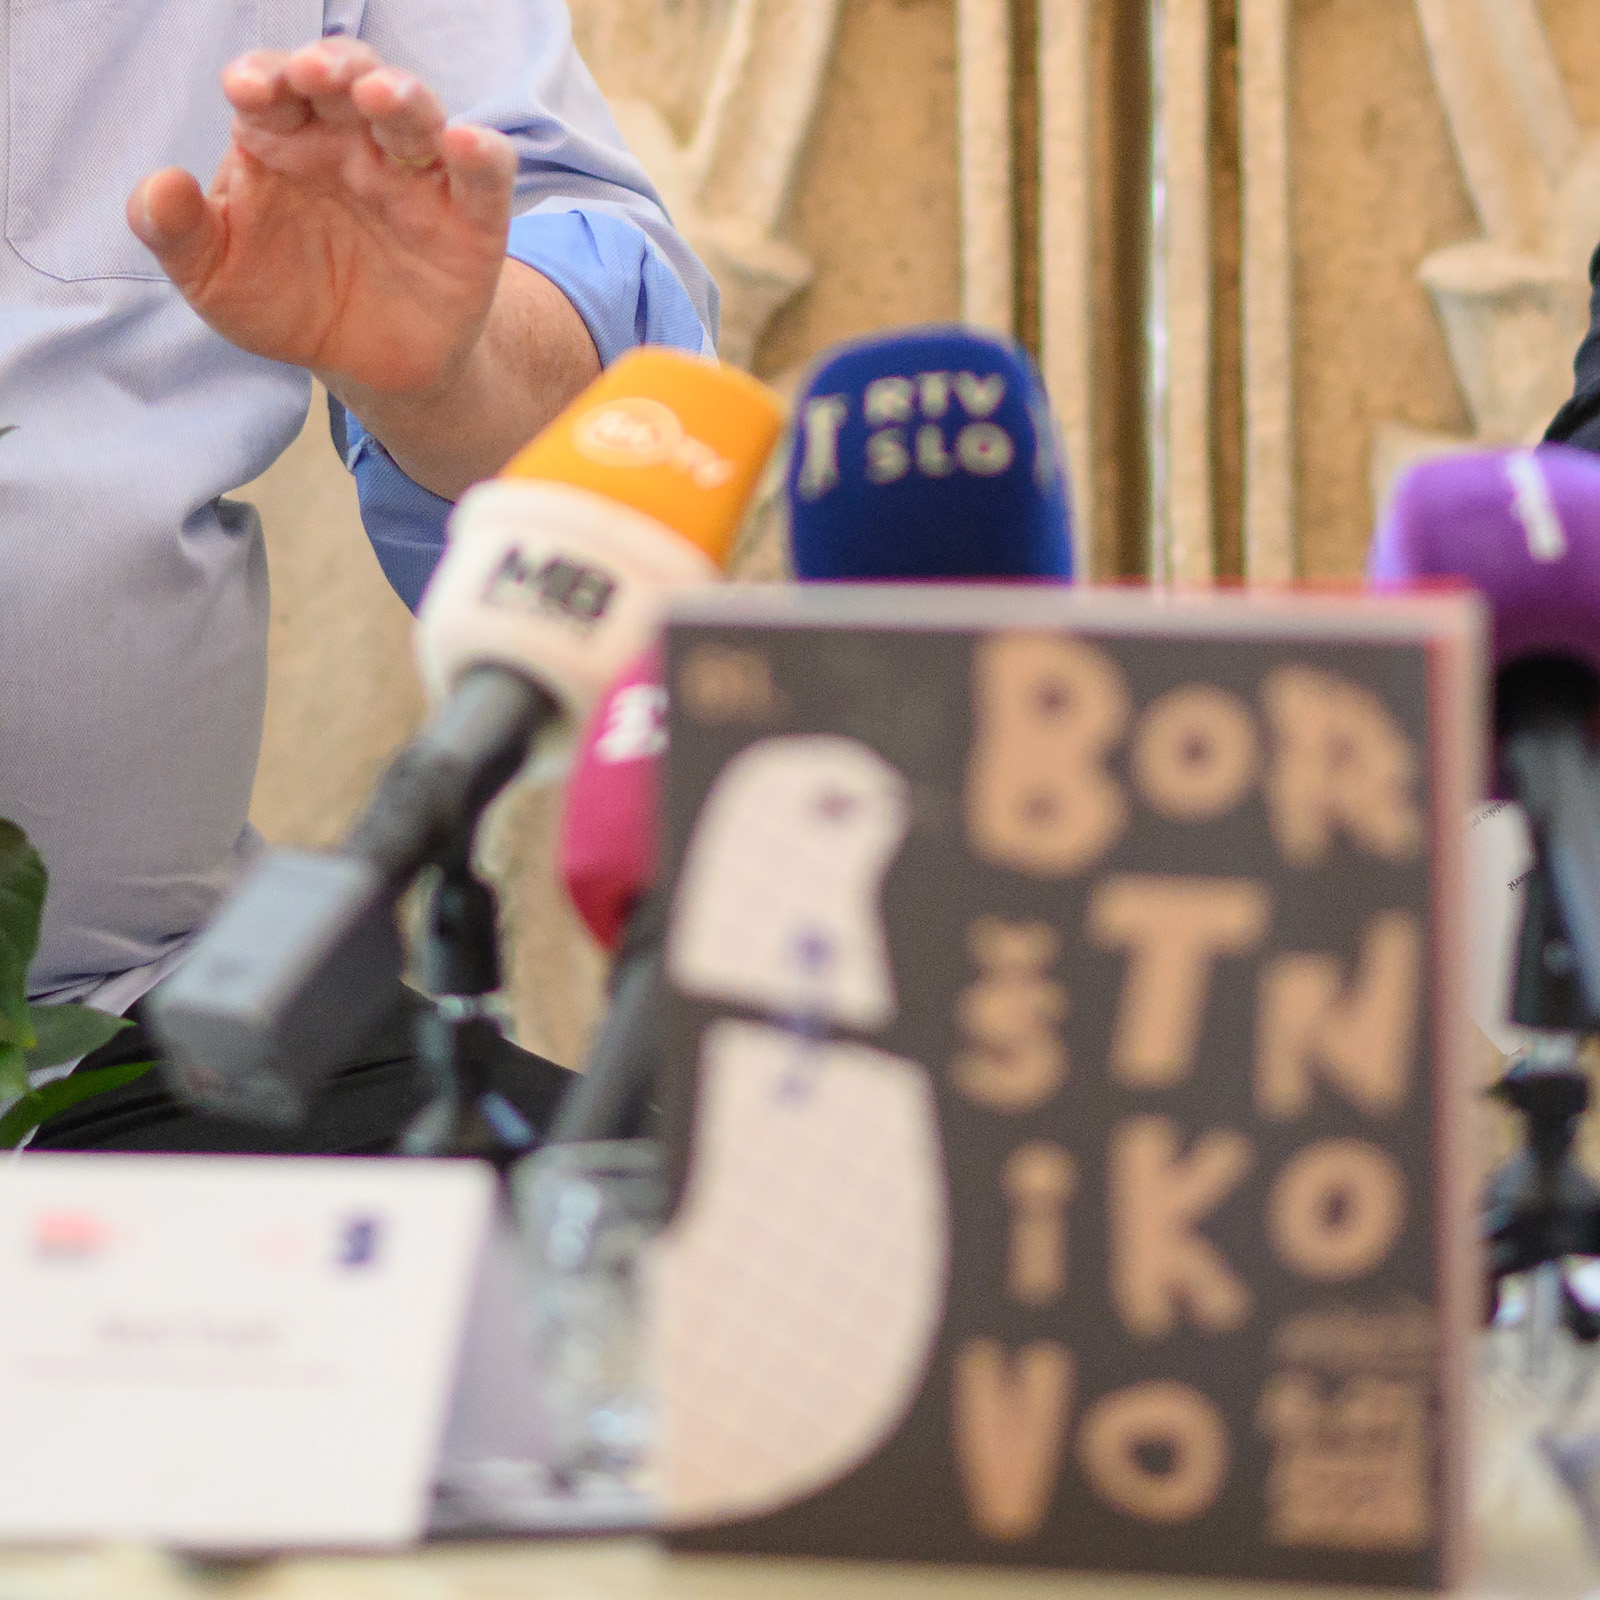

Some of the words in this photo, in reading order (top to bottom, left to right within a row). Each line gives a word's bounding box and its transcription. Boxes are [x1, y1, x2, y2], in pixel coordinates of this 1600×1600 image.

[863, 369, 1007, 429] RTV
[863, 420, 1017, 486] SLO
[1480, 799, 1507, 822] alsko
